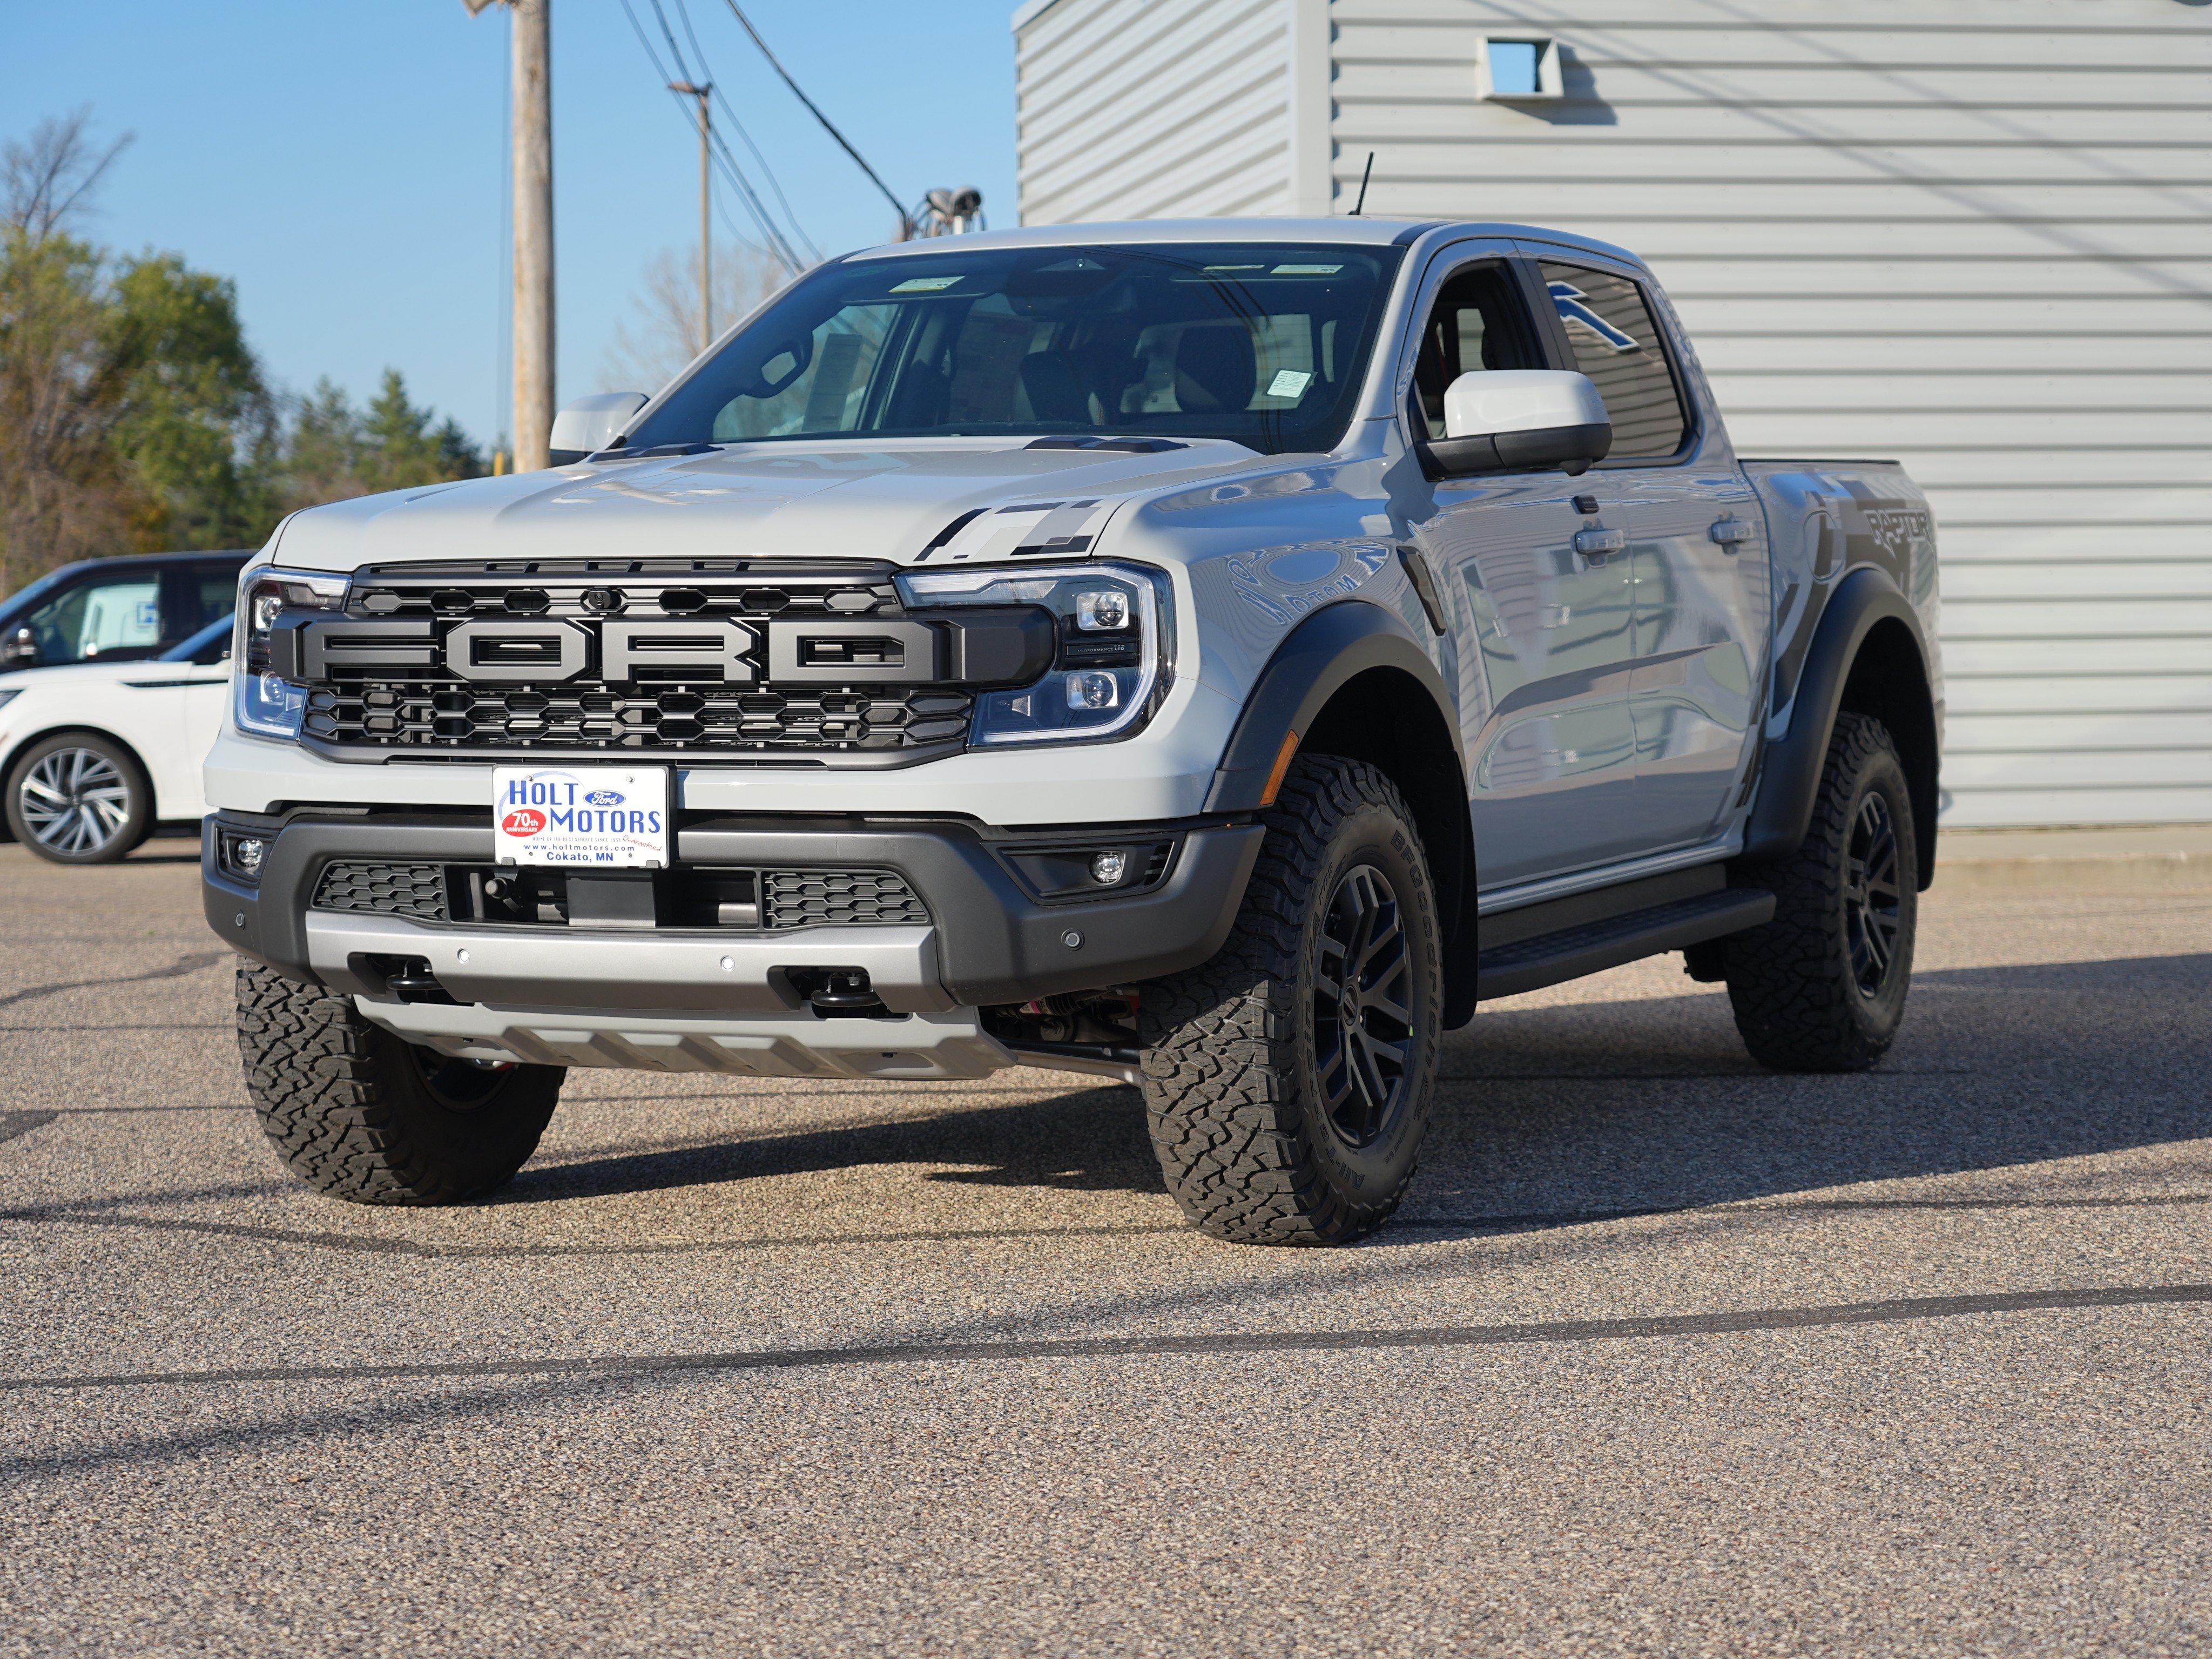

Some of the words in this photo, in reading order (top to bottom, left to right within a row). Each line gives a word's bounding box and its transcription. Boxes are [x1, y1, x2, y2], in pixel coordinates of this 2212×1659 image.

[1863, 509, 1935, 559] RAPTOR
[304, 617, 940, 684] FORD
[509, 780, 578, 805] HOLT
[590, 792, 618, 805] Ford
[512, 812, 538, 827] 70th
[550, 807, 661, 833] MOTORS
[623, 834, 663, 852] Guaranteed
[547, 852, 592, 862] Cokato,
[596, 853, 613, 861] MN
[1390, 830, 1438, 1068] BFGoodrich
